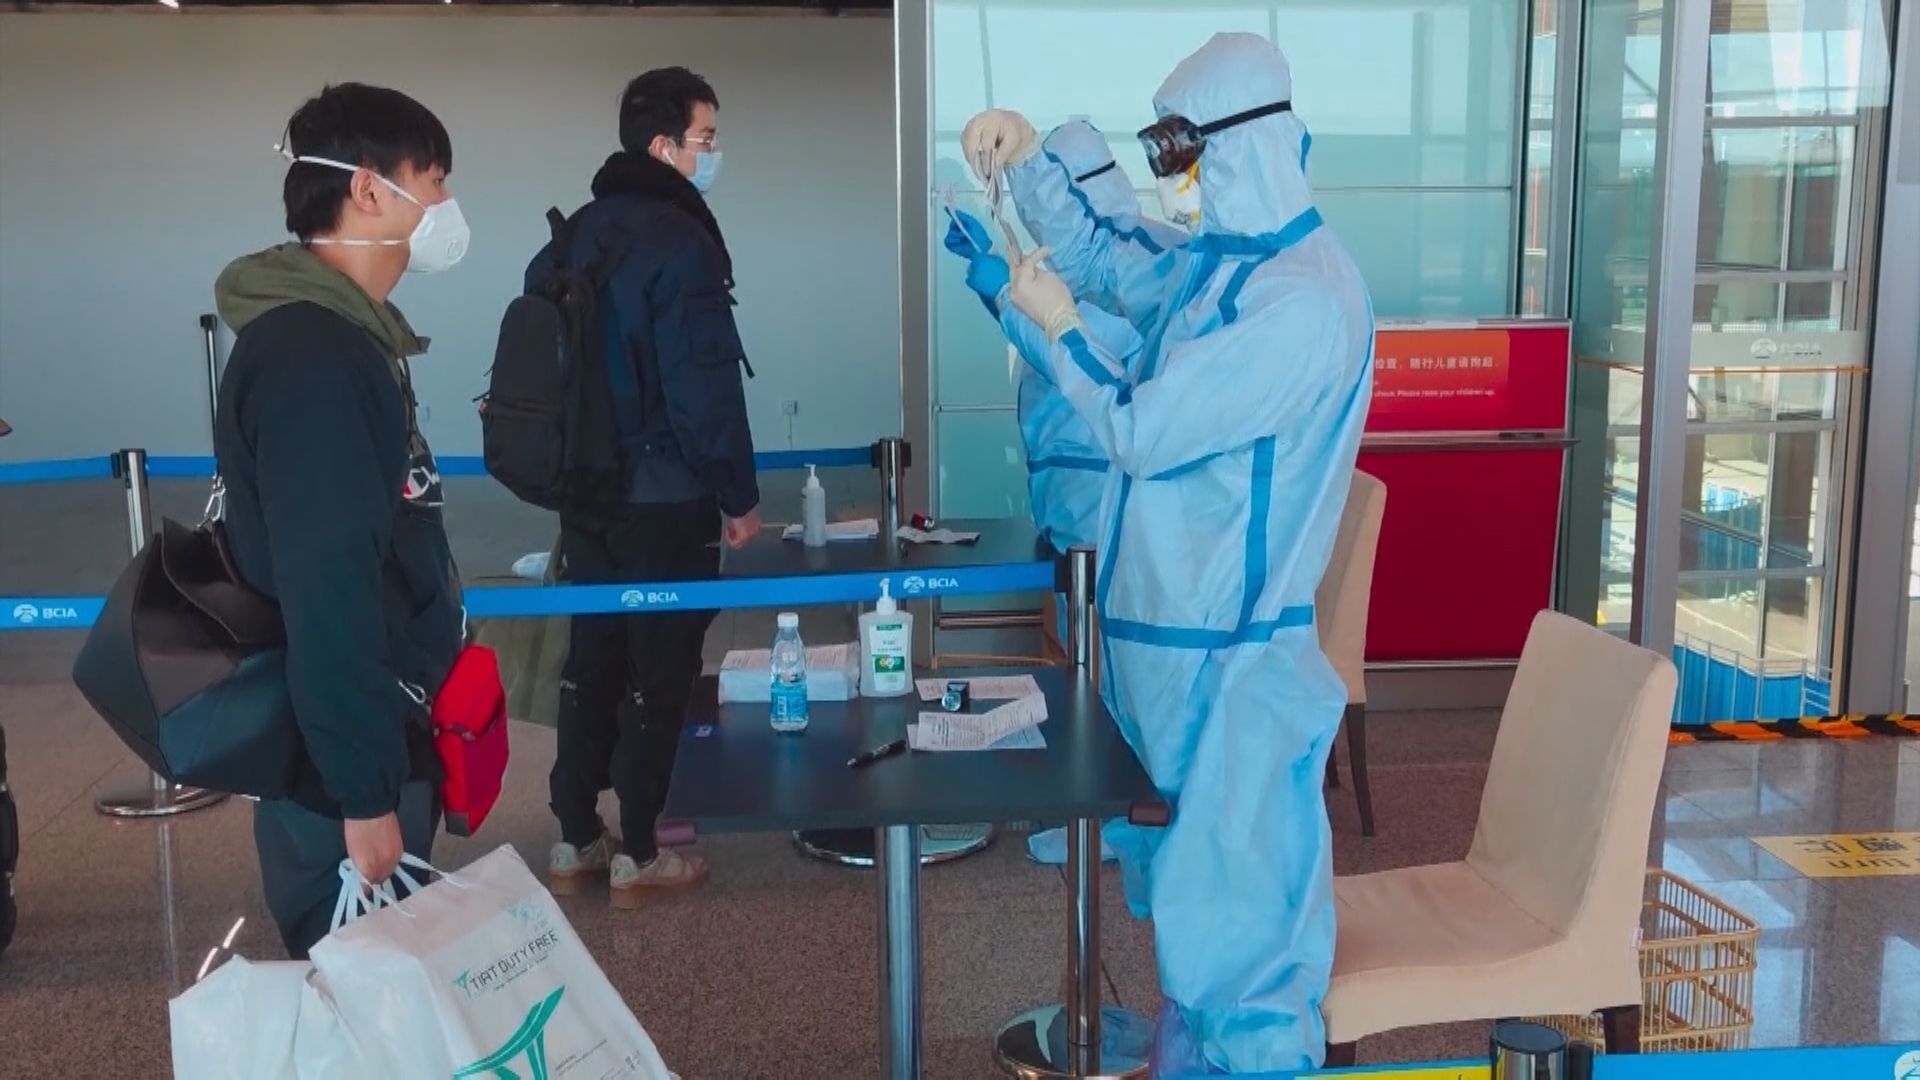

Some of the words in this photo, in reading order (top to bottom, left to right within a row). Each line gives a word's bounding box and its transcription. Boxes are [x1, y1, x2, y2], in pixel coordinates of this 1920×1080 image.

[928, 577, 959, 589] BCIA
[647, 591, 679, 603] BCIA
[42, 607, 78, 619] BCIA
[498, 945, 529, 974] DUTY
[527, 929, 559, 956] FREE
